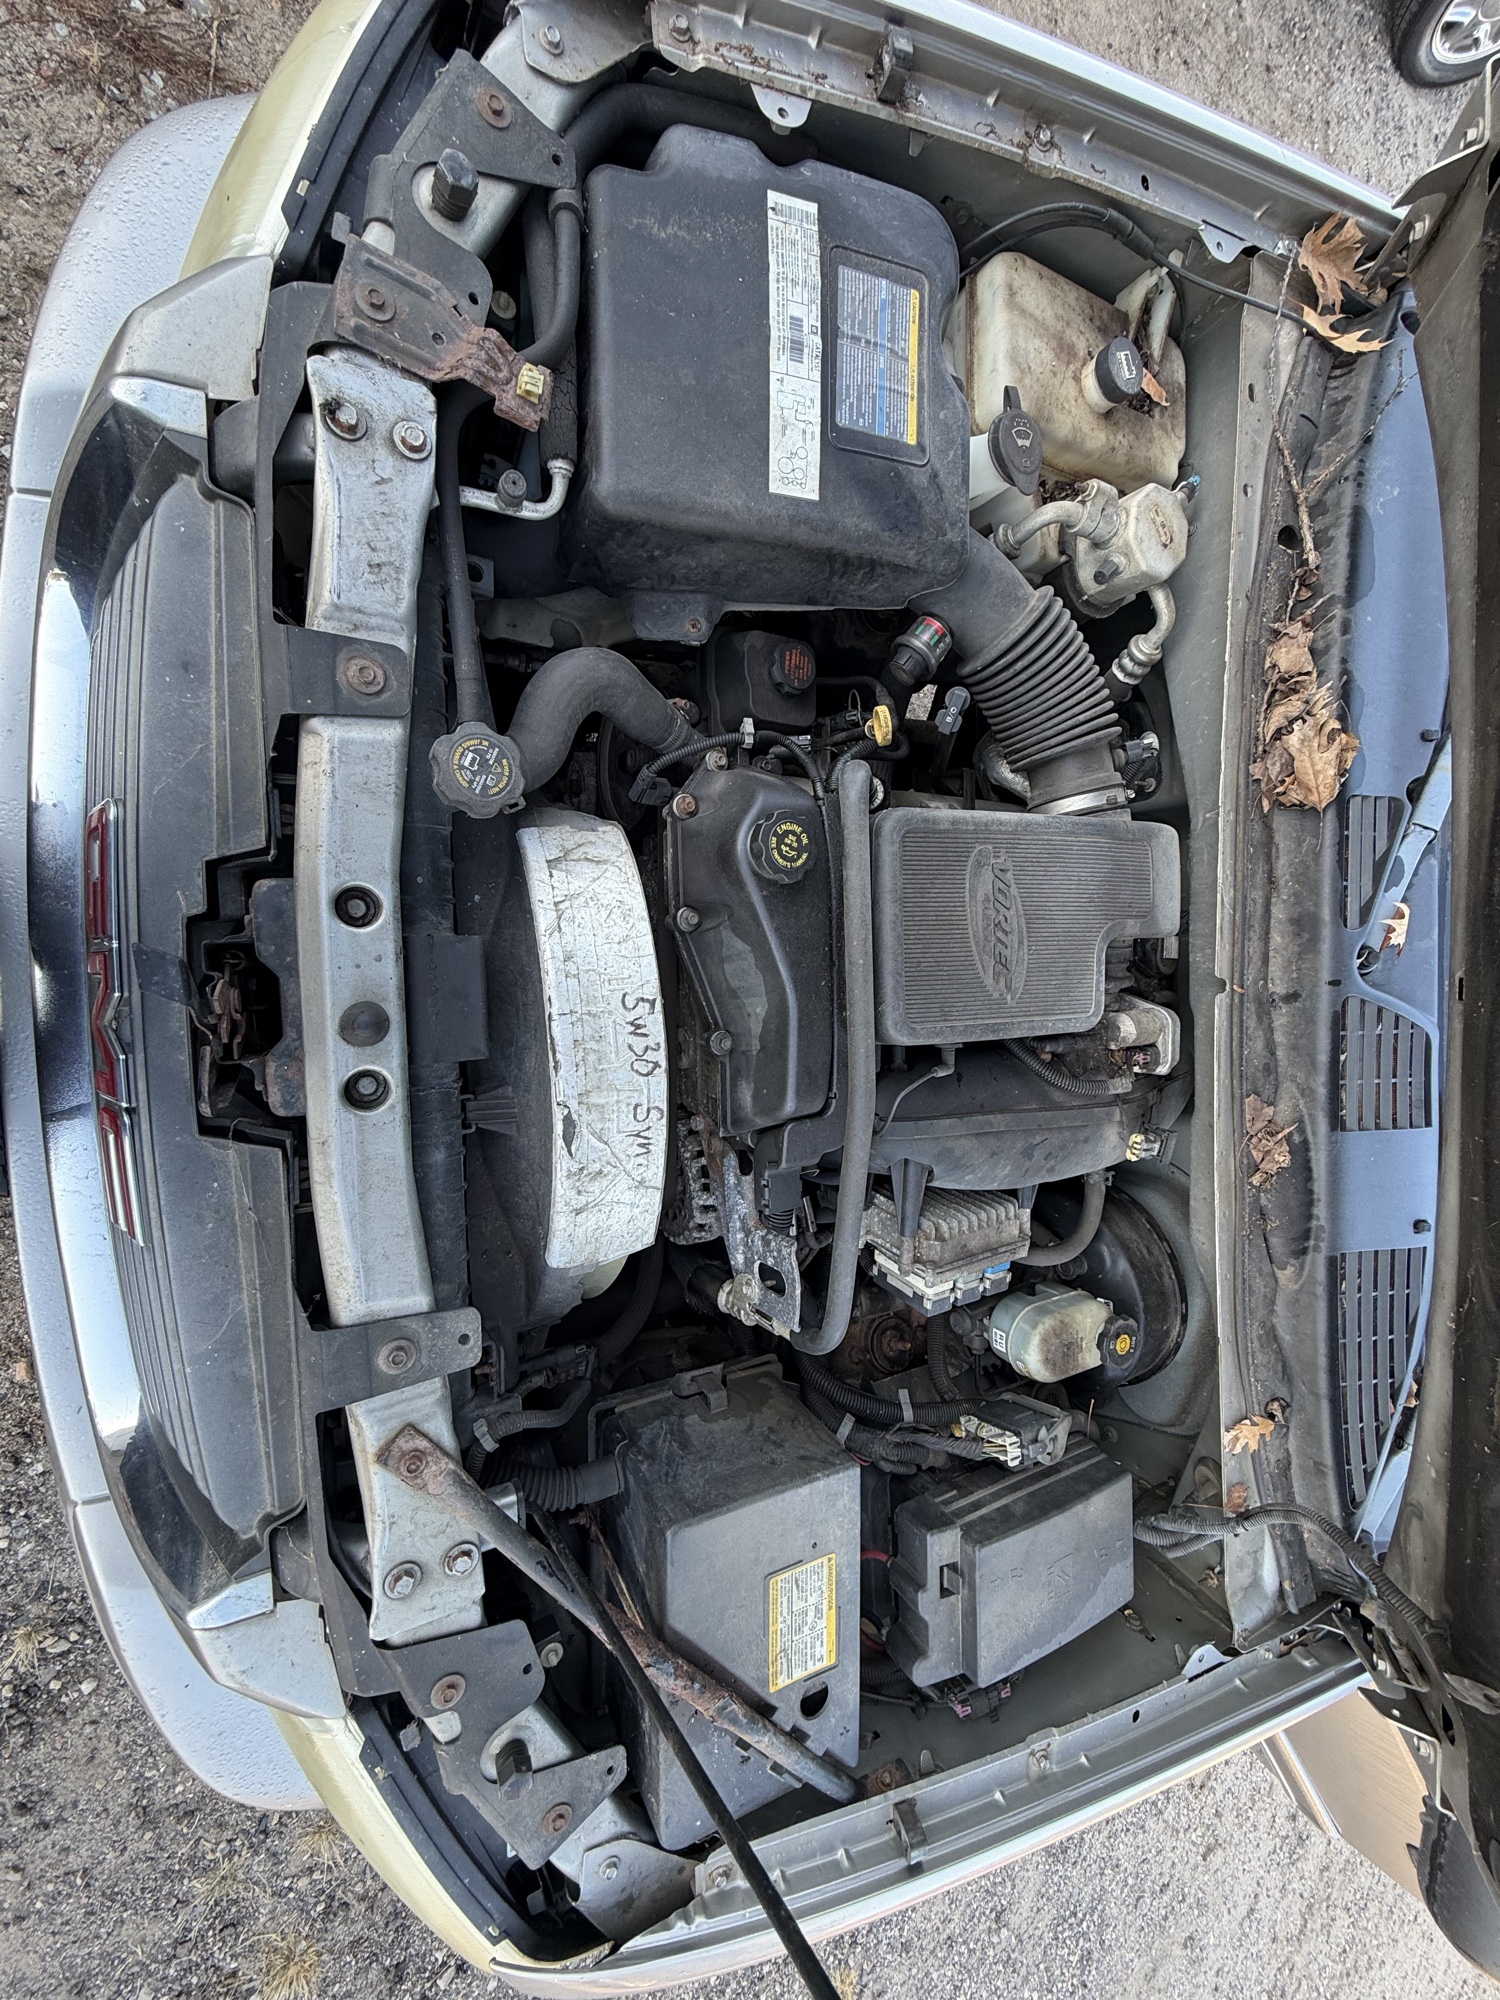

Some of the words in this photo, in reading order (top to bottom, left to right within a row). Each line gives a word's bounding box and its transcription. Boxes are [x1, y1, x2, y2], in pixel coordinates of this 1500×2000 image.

[814, 342, 822, 373] CATALYST
[462, 739, 480, 748] JAMAIS
[498, 776, 508, 789] OPEN
[776, 822, 803, 835] ENGINE
[800, 833, 809, 846] OIL
[772, 849, 791, 868] OWNER'S
[791, 852, 809, 868] MANUAL
[992, 859, 1012, 994] VORTEC
[86, 798, 146, 1247] GMC
